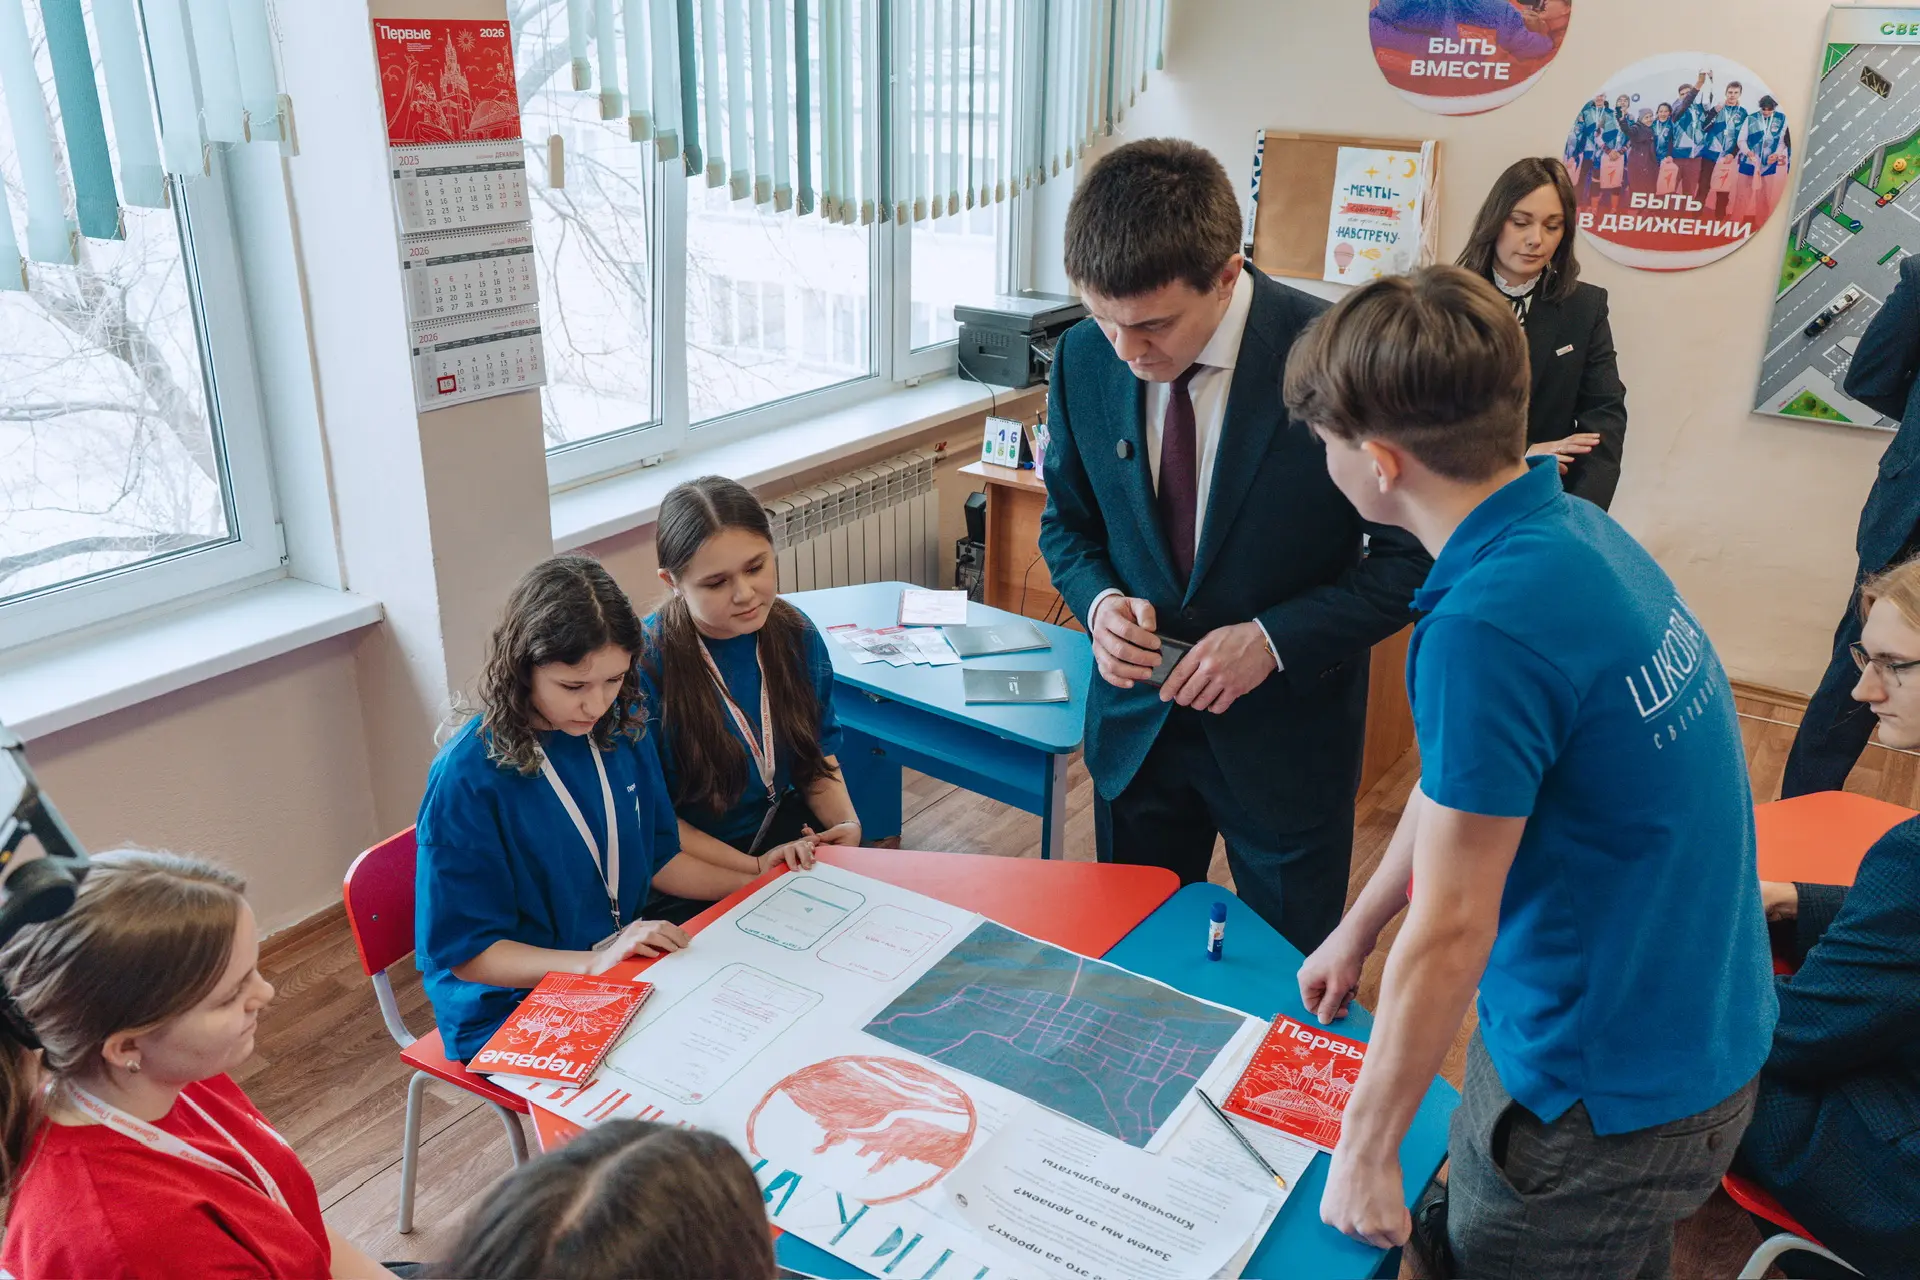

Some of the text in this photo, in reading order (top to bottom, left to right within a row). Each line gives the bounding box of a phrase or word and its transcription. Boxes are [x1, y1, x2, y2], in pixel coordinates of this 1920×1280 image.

[381, 26, 505, 44] Первые 2026
[1428, 37, 1496, 55] БЫТЬ
[1410, 59, 1510, 80] ВМЕСТЕ
[399, 156, 419, 165] 2025
[1630, 192, 1702, 212] БЫТЬ
[1578, 212, 1752, 238] В ДВИЖЕНИИ
[410, 247, 430, 257] 2026
[418, 333, 438, 344] 2026
[998, 429, 1018, 443] 1 6
[479, 1050, 586, 1078] Первые
[1042, 1158, 1120, 1194] результаты
[1122, 1193, 1195, 1230] Ключевые
[1014, 1187, 1172, 1261] Зачем мы это делаем?
[988, 1224, 1090, 1276] это за проект?
